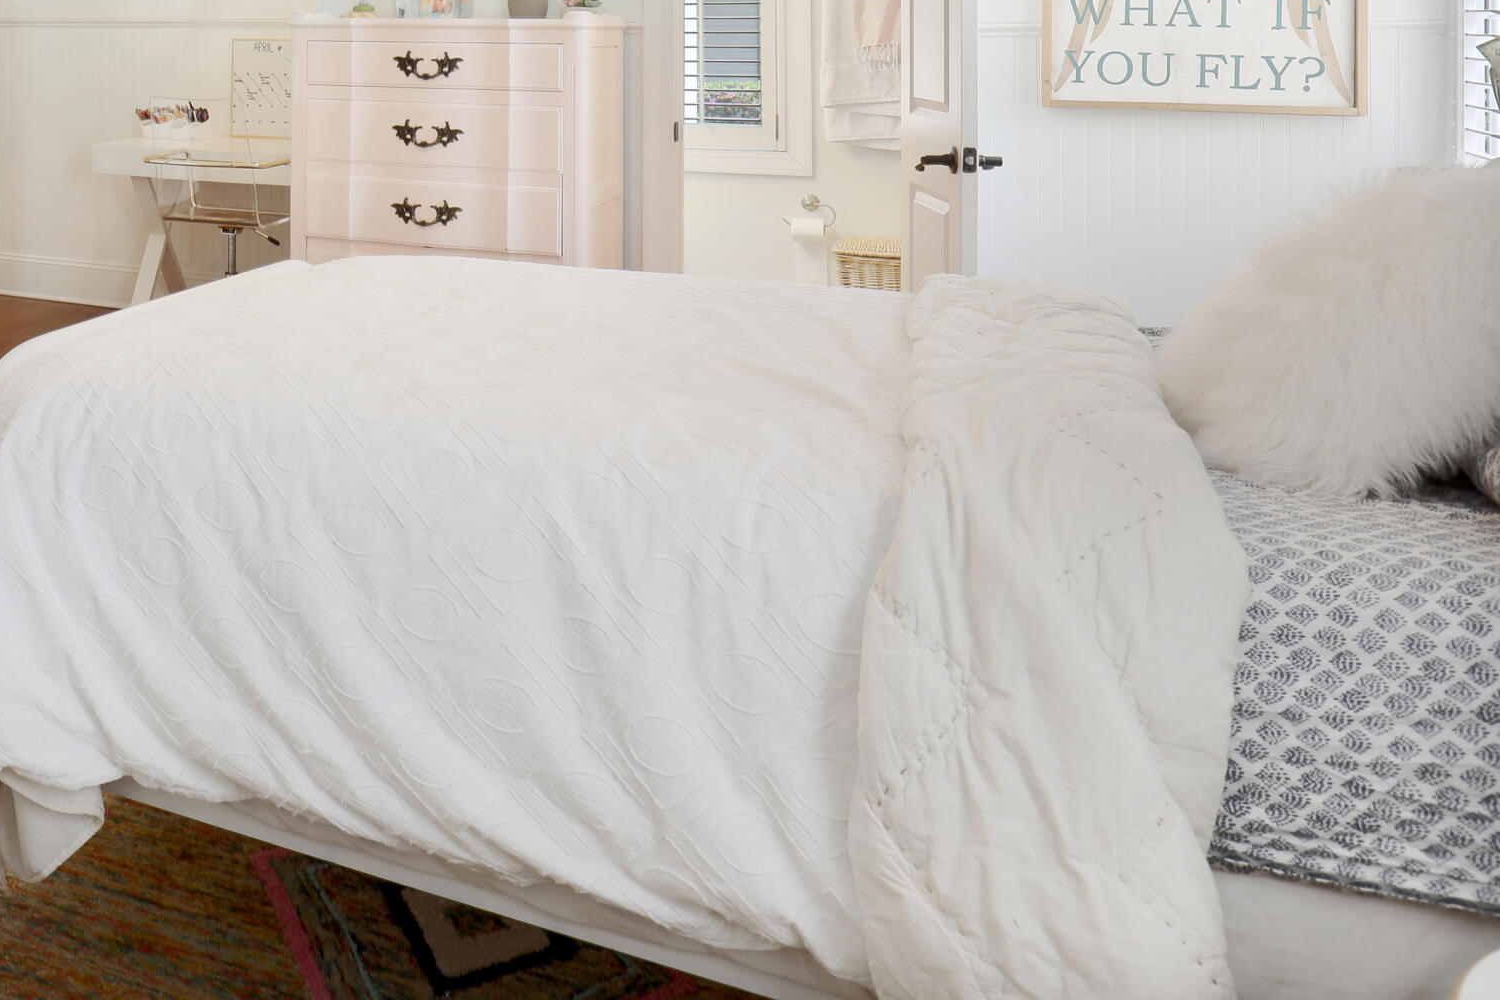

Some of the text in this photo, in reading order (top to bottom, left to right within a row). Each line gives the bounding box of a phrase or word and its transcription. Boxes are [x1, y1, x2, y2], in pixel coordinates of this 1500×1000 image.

[252, 41, 274, 53] APRIL
[1064, 51, 1326, 92] YOU FLY?
